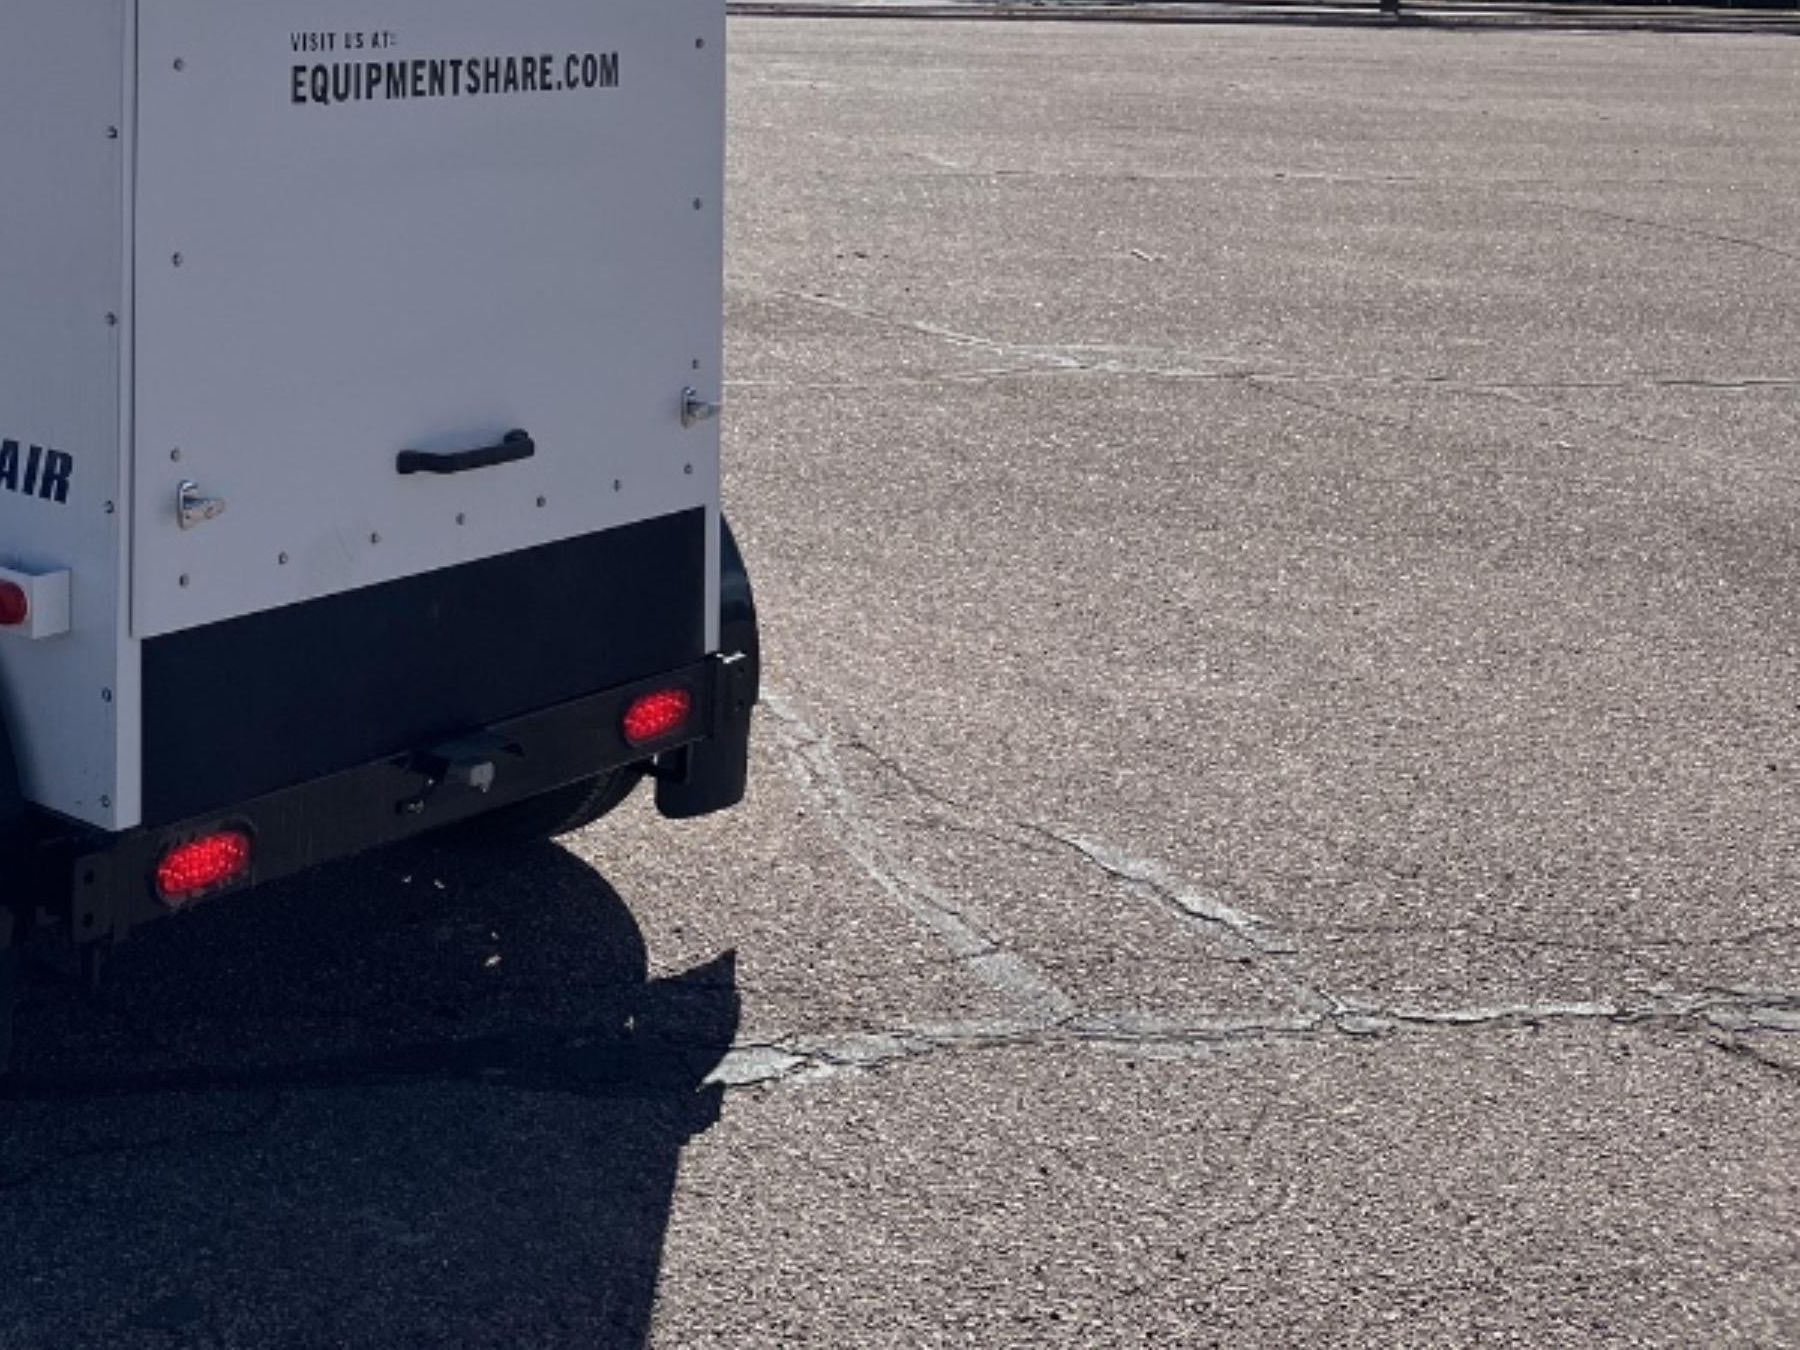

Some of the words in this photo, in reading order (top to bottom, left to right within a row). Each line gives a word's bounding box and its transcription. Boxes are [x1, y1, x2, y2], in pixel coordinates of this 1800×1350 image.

[290, 32, 336, 52] VISIT
[344, 32, 364, 49] US
[371, 30, 397, 50] AT:
[290, 52, 619, 105] EQUIPMENTSHARE.COM
